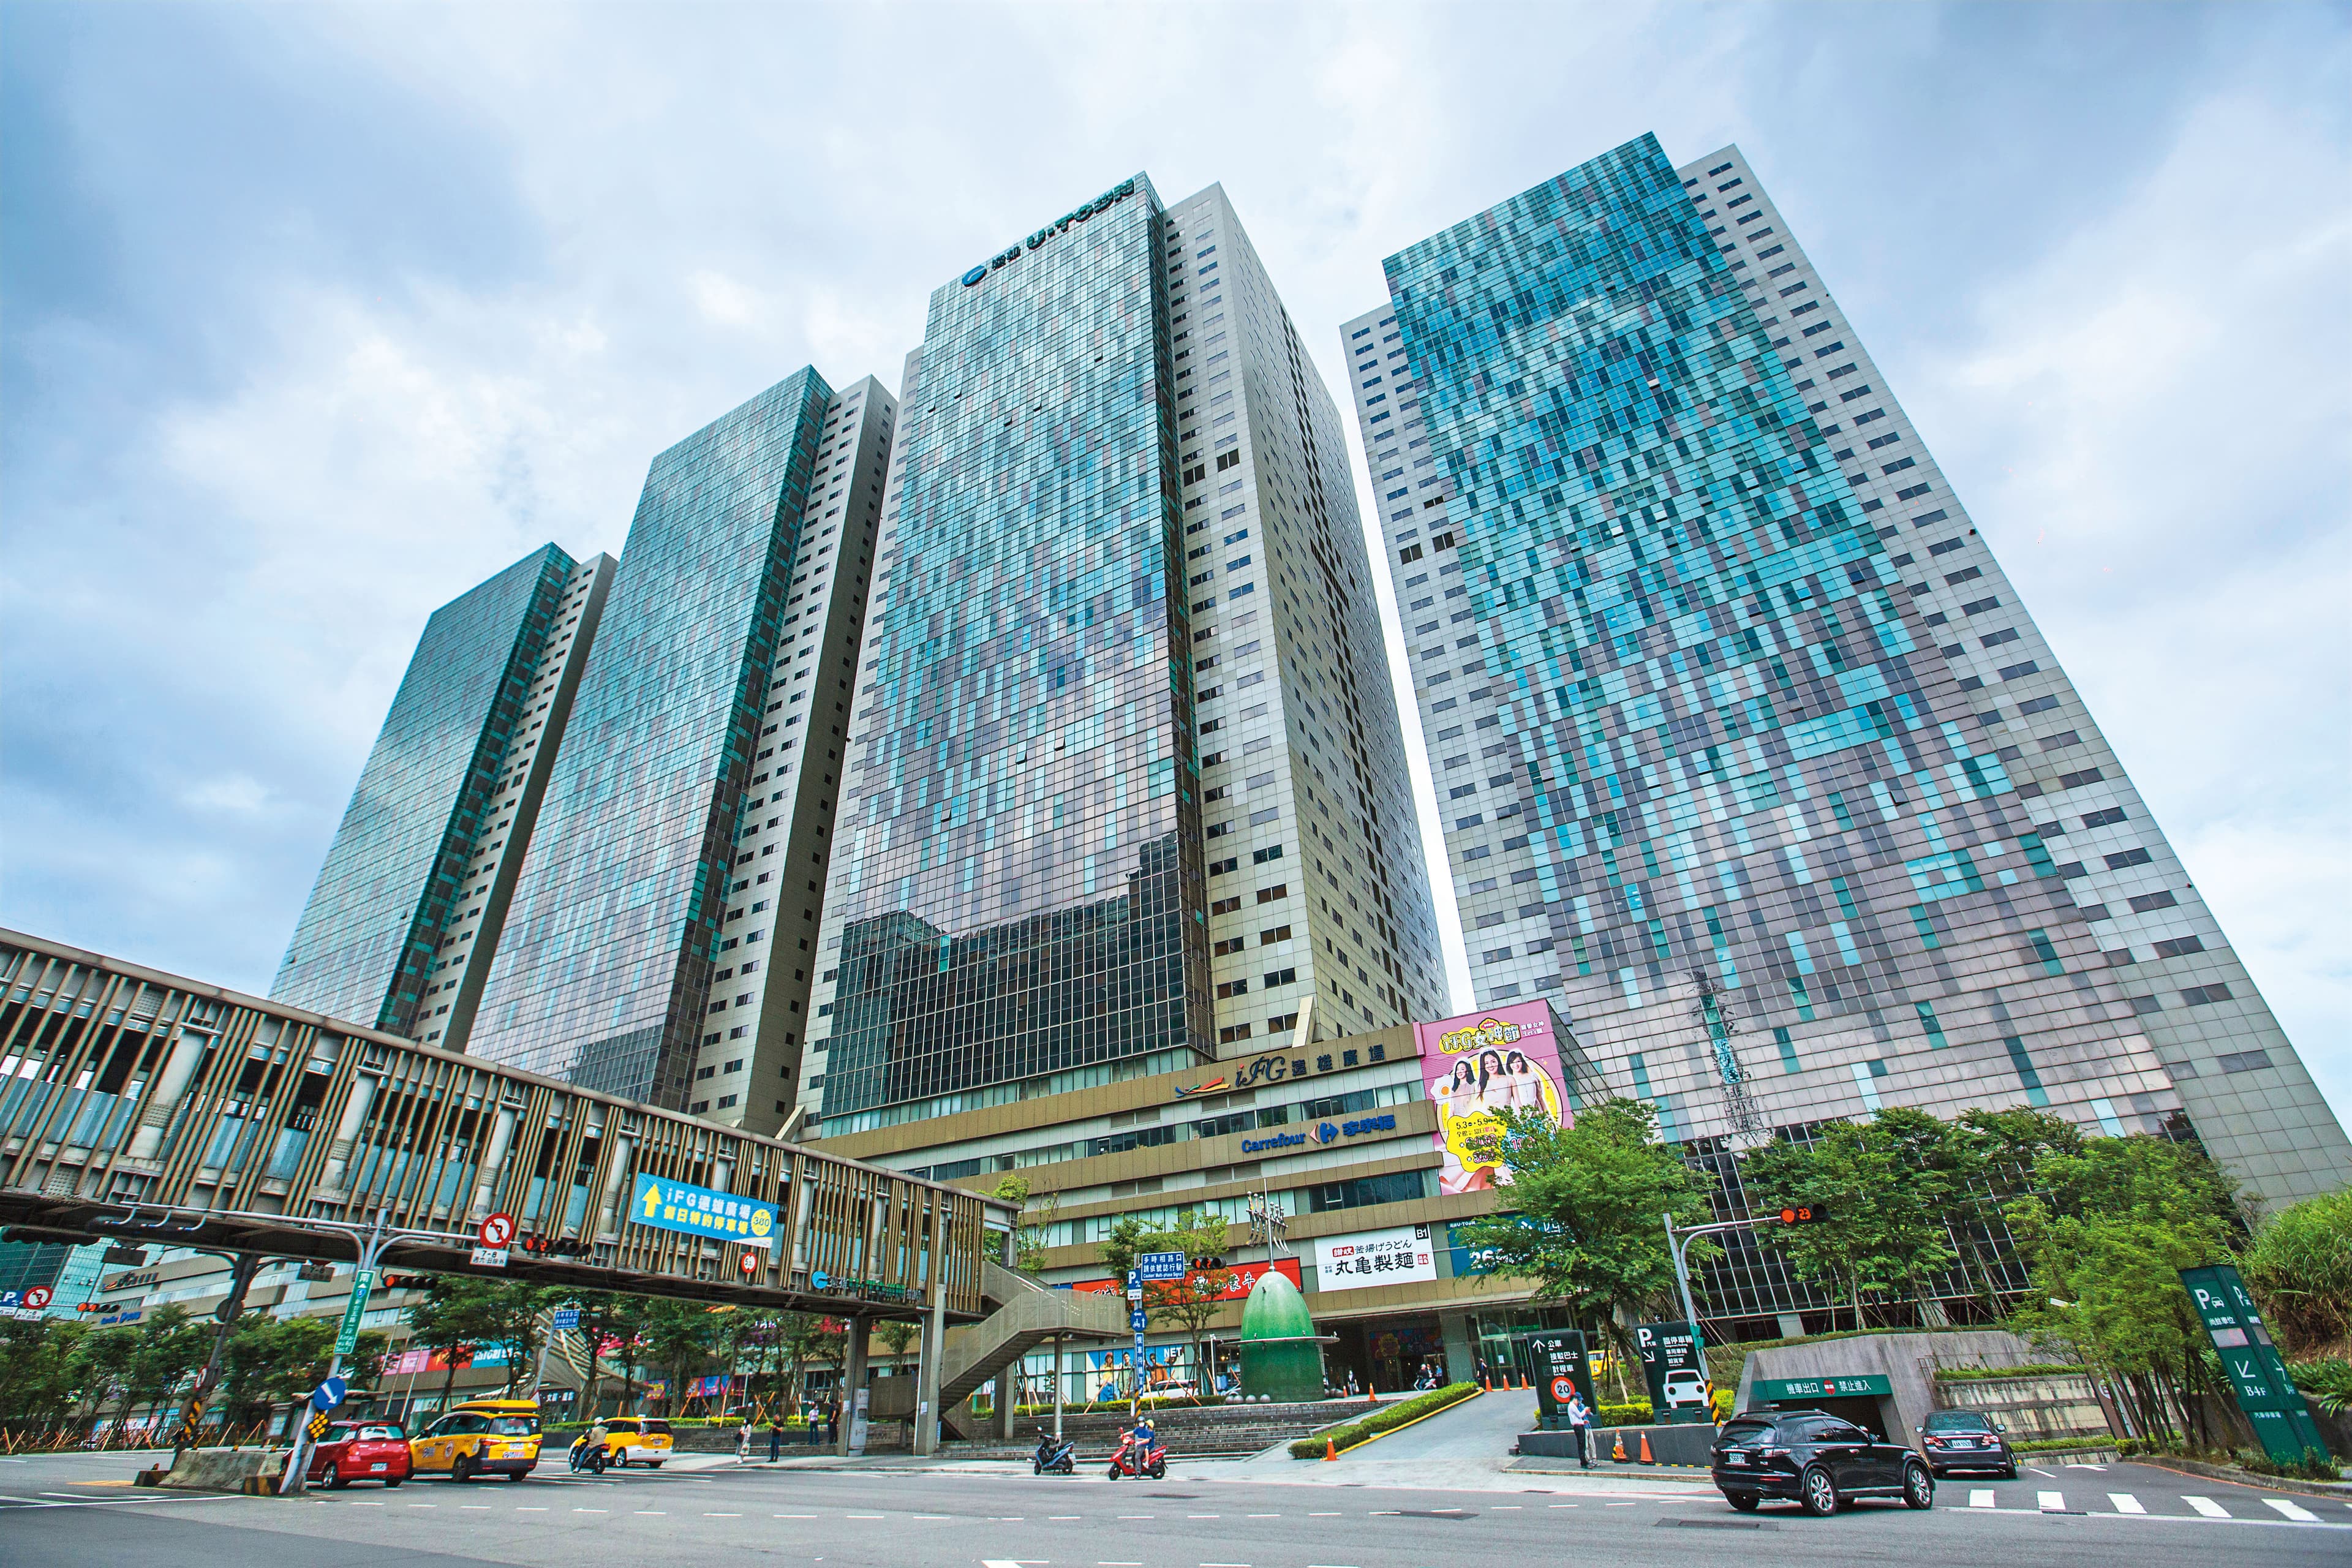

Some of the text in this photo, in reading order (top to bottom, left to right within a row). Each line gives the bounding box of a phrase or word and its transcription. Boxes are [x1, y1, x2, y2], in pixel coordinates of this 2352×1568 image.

[1292, 1044, 1385, 1076] 遠雄廣場
[1242, 1114, 1396, 1153] Carrefour 家樂福
[1798, 1208, 1811, 1220] 23
[753, 1216, 770, 1226] 300
[1417, 1229, 1428, 1238] B1
[1144, 1254, 1182, 1264] 多時相路口
[1144, 1263, 1182, 1273] 請依號誌行駛
[1129, 1271, 1136, 1284] P
[3, 1292, 17, 1302] P
[2194, 1289, 2210, 1310] P
[2233, 1286, 2244, 1306] P
[1637, 1328, 1653, 1348] P
[1164, 1347, 1182, 1357] NET
[1550, 1351, 1578, 1360] 接駁巴士
[1552, 1364, 1574, 1373] 計程車
[1557, 1385, 1569, 1393] 20
[1786, 1380, 1872, 1394] 機車出口 禁止進入
[2244, 1385, 2266, 1396] B4F
